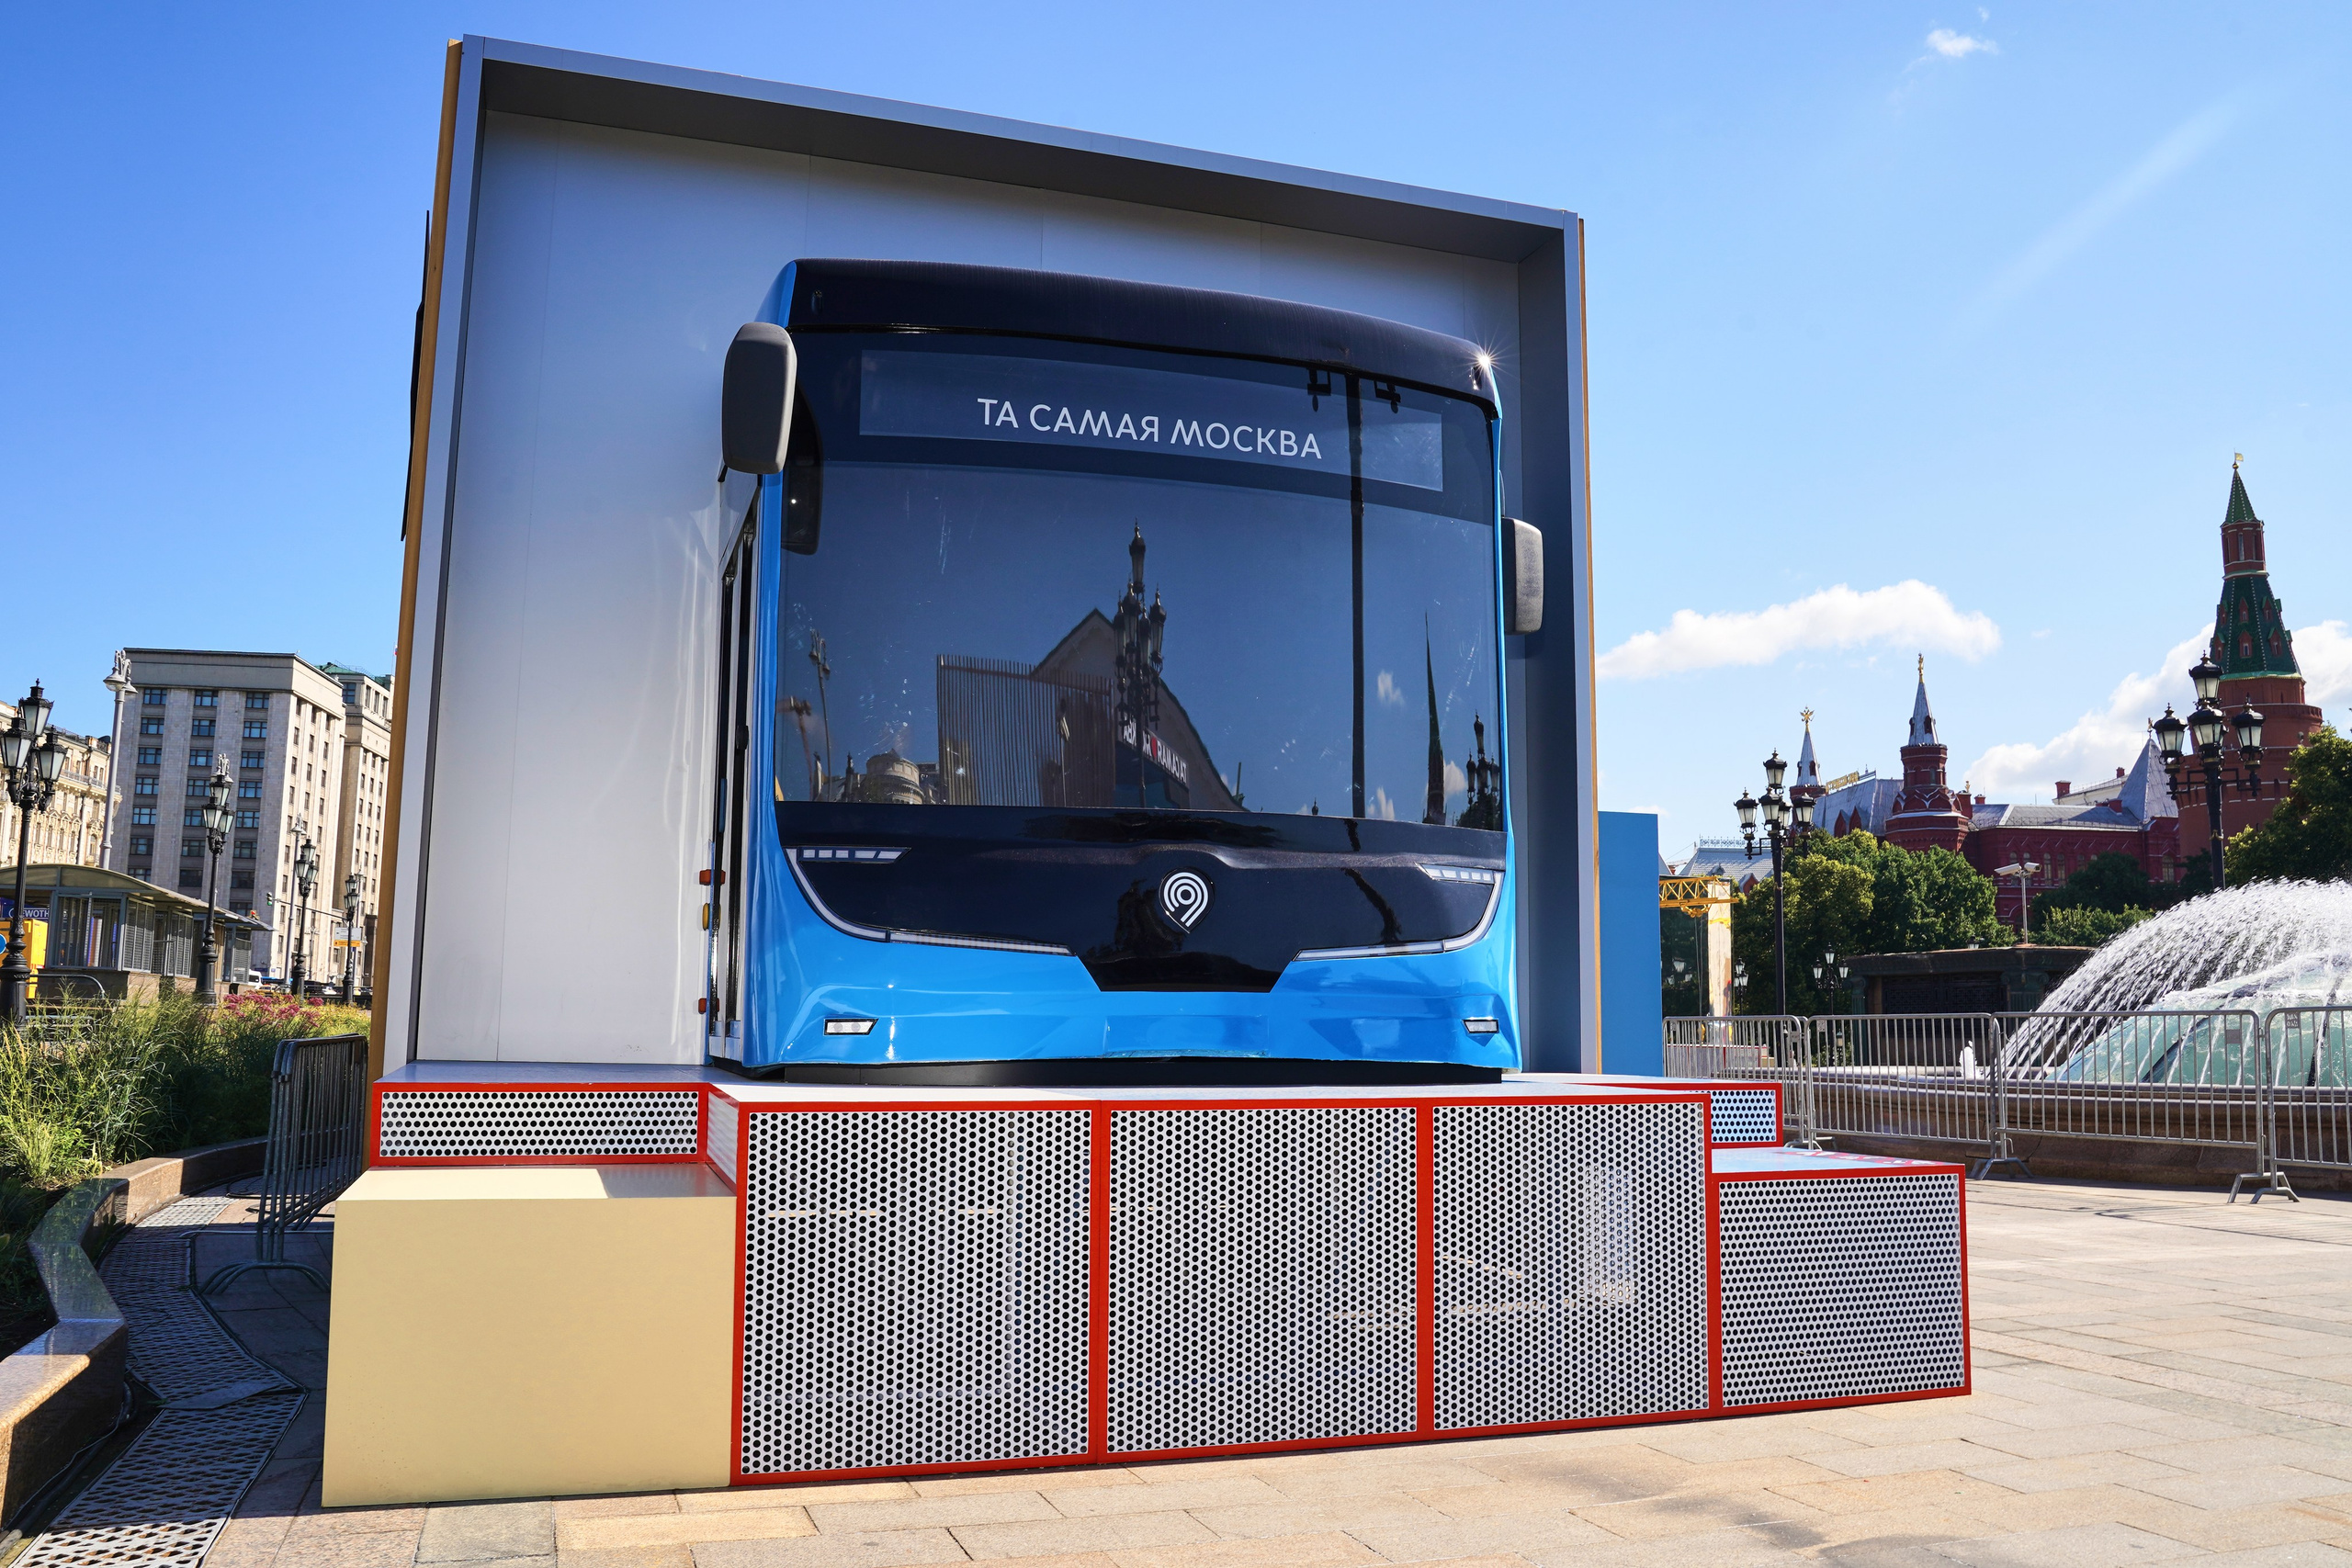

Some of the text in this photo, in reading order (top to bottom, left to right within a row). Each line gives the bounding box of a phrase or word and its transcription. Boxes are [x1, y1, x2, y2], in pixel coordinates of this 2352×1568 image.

[977, 398, 1323, 459] ТА САМАЯ МОСКВА
